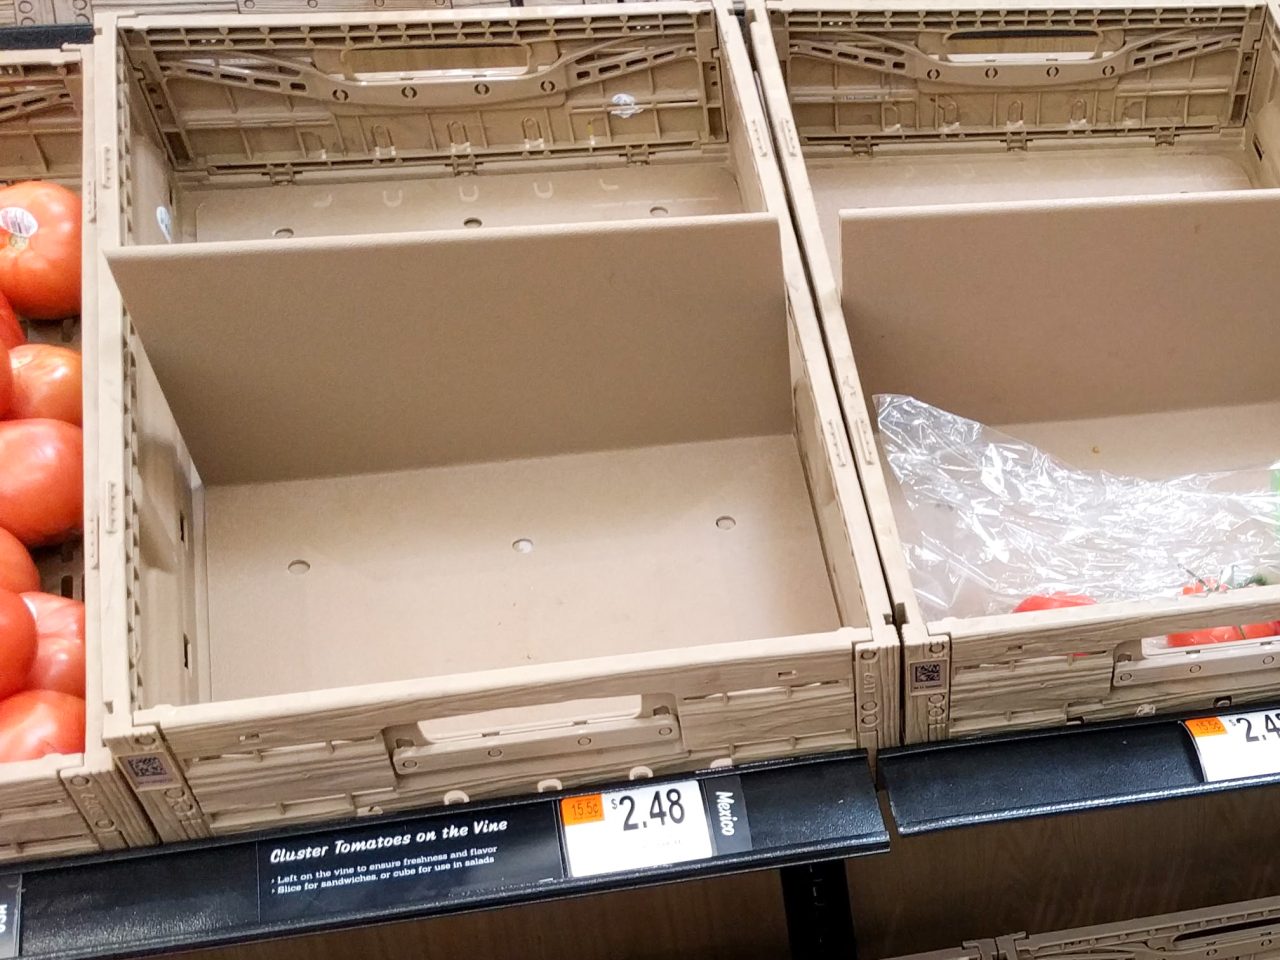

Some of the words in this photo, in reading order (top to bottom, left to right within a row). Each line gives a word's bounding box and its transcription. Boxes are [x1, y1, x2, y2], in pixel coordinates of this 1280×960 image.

[571, 801, 600, 817] 15.5¢
[715, 791, 738, 836] Mexico
[270, 846, 329, 864] Cluster
[334, 834, 411, 854] Tomatoes
[415, 831, 437, 843] on
[442, 825, 470, 840] the
[473, 819, 508, 835] Vine
[277, 874, 299, 884] Left
[300, 872, 313, 881] on
[315, 869, 332, 879] the
[333, 866, 355, 876] vine
[357, 864, 367, 873] to
[368, 860, 402, 872] ensure
[403, 853, 449, 868] freshness
[450, 849, 469, 860] and
[470, 846, 499, 857] flavor
[277, 884, 302, 895] Slice
[304, 881, 320, 891] for
[380, 872, 391, 880] or
[393, 867, 418, 878] cube
[419, 864, 433, 875] for
[434, 863, 451, 872] use
[453, 859, 464, 868] in
[465, 855, 496, 867] salads
